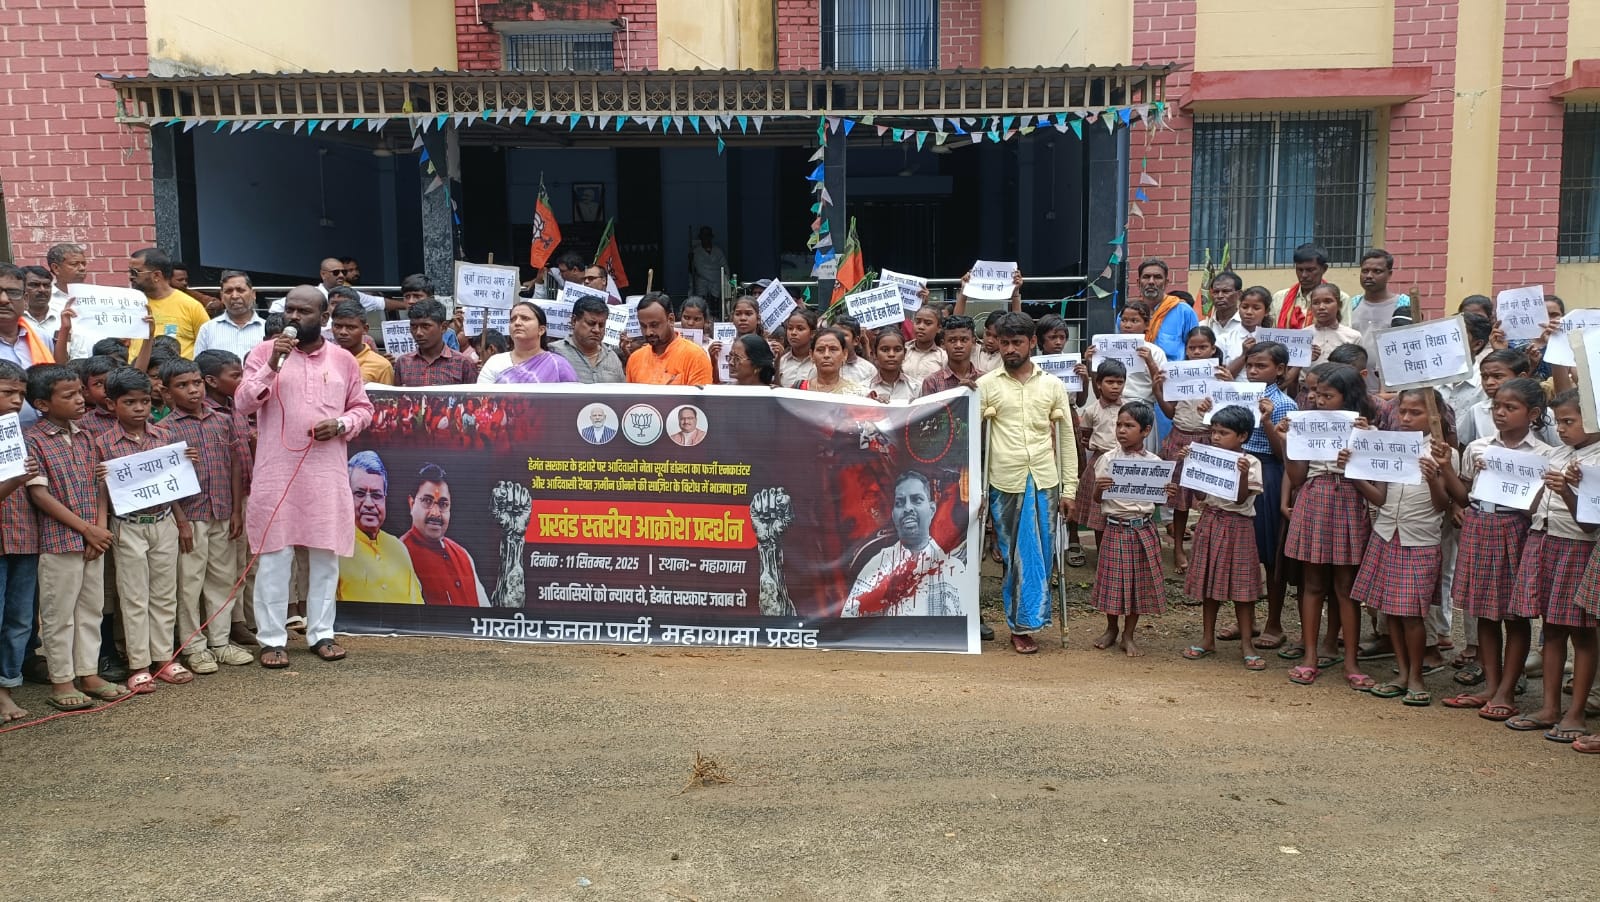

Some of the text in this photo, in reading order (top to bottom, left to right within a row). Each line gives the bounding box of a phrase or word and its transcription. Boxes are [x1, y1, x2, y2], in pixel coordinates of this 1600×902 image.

[1384, 341, 1398, 356] हमें
[1425, 334, 1447, 348] शिक्षा
[1451, 328, 1460, 342] दो
[1404, 353, 1442, 372] शिक्षा दो
[1198, 380, 1206, 394] दो
[1308, 439, 1326, 448] अमर
[1353, 438, 1420, 454] दोषी को सजा दो
[115, 450, 180, 481] हमें न्याय दो
[528, 457, 544, 470] हेमंत
[545, 460, 568, 471] सरकार
[570, 458, 577, 471] के
[578, 459, 596, 472] इशारे
[597, 461, 607, 472] पर
[608, 459, 638, 472] आदिवासी
[640, 459, 652, 473] नेता
[691, 463, 701, 474] का
[1371, 457, 1403, 471] सजा दो
[1488, 456, 1502, 472] दोषी
[1505, 460, 1514, 474] को
[1519, 465, 1535, 478] सजा
[131, 474, 179, 500] न्याय दो
[532, 476, 545, 489] और
[546, 476, 577, 490] आदिवासी
[638, 478, 647, 491] की
[673, 479, 680, 491] के
[681, 479, 700, 493] विरोध
[701, 480, 710, 493] में
[710, 483, 731, 494] भाजपा
[732, 483, 748, 495] द्वारा
[1502, 482, 1530, 496] सजा दो
[538, 507, 745, 542] प्रखंड स्तरीय आक्रोश प्रदर्शन
[530, 551, 559, 568] दिनांक
[566, 556, 574, 569] 11
[576, 552, 613, 571] सितम्बर,
[615, 557, 639, 570] 2025
[699, 559, 747, 574] महागामा
[538, 582, 747, 607] आदिवासियों को न्याय दो, हेमंत सरकार जवाब दो
[471, 613, 819, 648] भारतीय जनता पार्टी, महागामा प्रखंड
